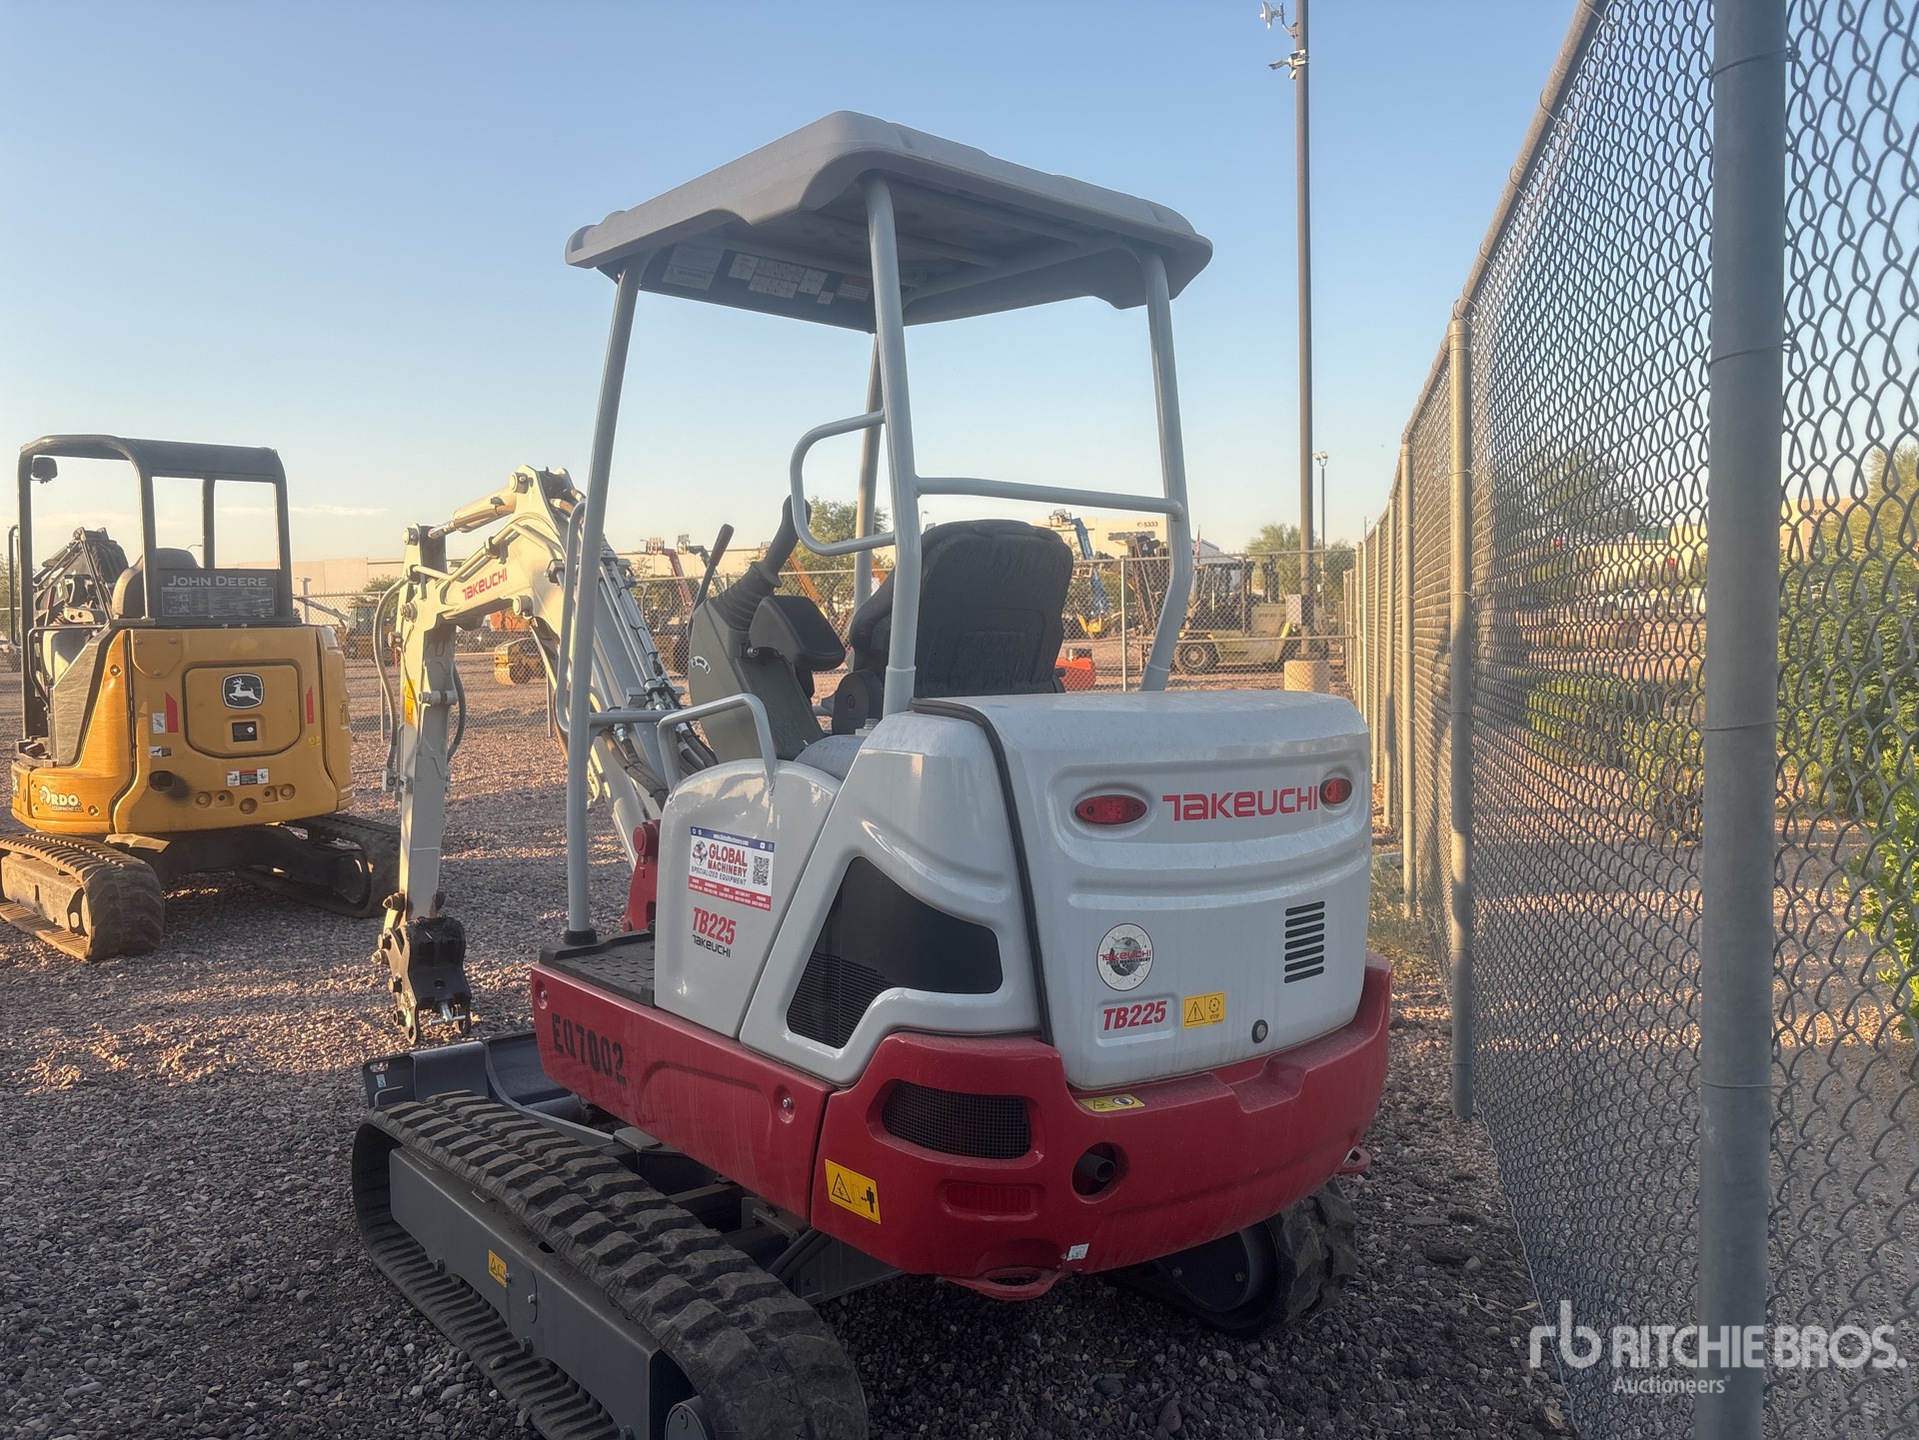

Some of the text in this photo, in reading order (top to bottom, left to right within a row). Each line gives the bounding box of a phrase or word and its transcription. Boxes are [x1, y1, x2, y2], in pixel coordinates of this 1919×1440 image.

[168, 575, 267, 587] JOHN DEERE
[462, 568, 508, 601] TAKEUCHI
[1162, 785, 1318, 822] TAKEUCHI
[709, 843, 748, 867] GLOBAL
[691, 865, 747, 885] SPECIALIZED EQUIPMENT
[707, 860, 747, 877] MACHINERY
[692, 906, 737, 945] TB225
[692, 934, 731, 958] TAKEUCHI
[1099, 949, 1152, 961] TAKEUCHI
[1103, 1000, 1167, 1031] TB225
